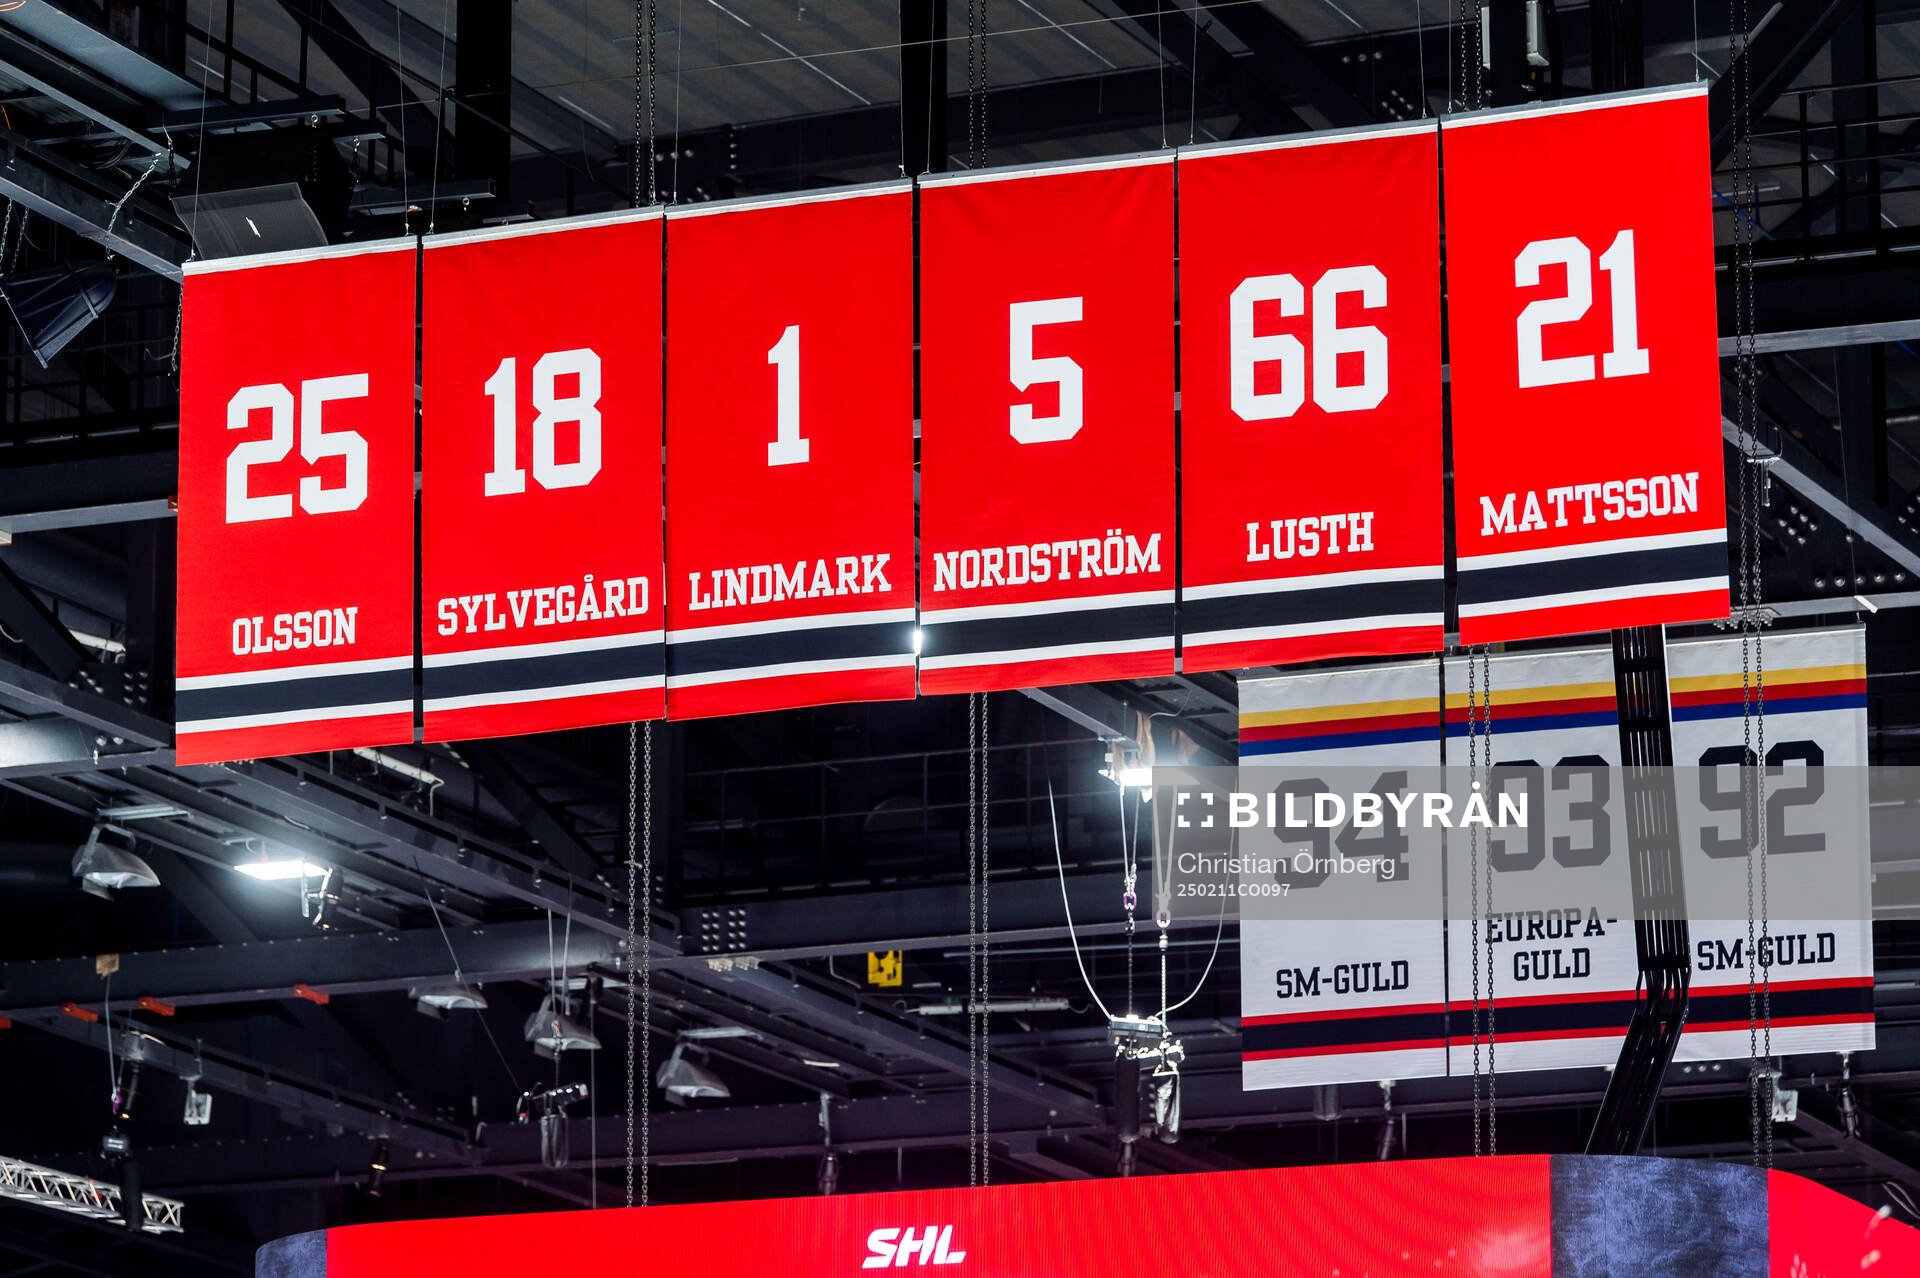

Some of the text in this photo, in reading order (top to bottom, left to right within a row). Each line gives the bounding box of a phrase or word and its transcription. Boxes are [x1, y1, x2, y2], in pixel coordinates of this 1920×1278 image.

[1515, 229, 1649, 388] 21
[1010, 297, 1083, 444] 5
[1230, 265, 1388, 421] 66
[485, 348, 601, 496] 18
[768, 325, 809, 466] 1
[226, 373, 368, 523] 25
[1480, 472, 1698, 536] MATTSSON
[934, 529, 1161, 591] NORDSTRÖM
[1247, 512, 1374, 562] LUSTH
[438, 574, 648, 635] SYLVEGÅRD
[689, 554, 891, 610] LINDMARK
[233, 607, 358, 655] OLSSON
[1273, 770, 1409, 889] 94
[1491, 755, 1611, 872] 93
[1699, 740, 1826, 859] 92
[1485, 906, 1617, 943] EUROPA-
[1696, 932, 1836, 971] SM-GULD
[1276, 960, 1409, 999] SM-GULD
[1513, 948, 1591, 981] GULD
[862, 1225, 966, 1268] SHL
